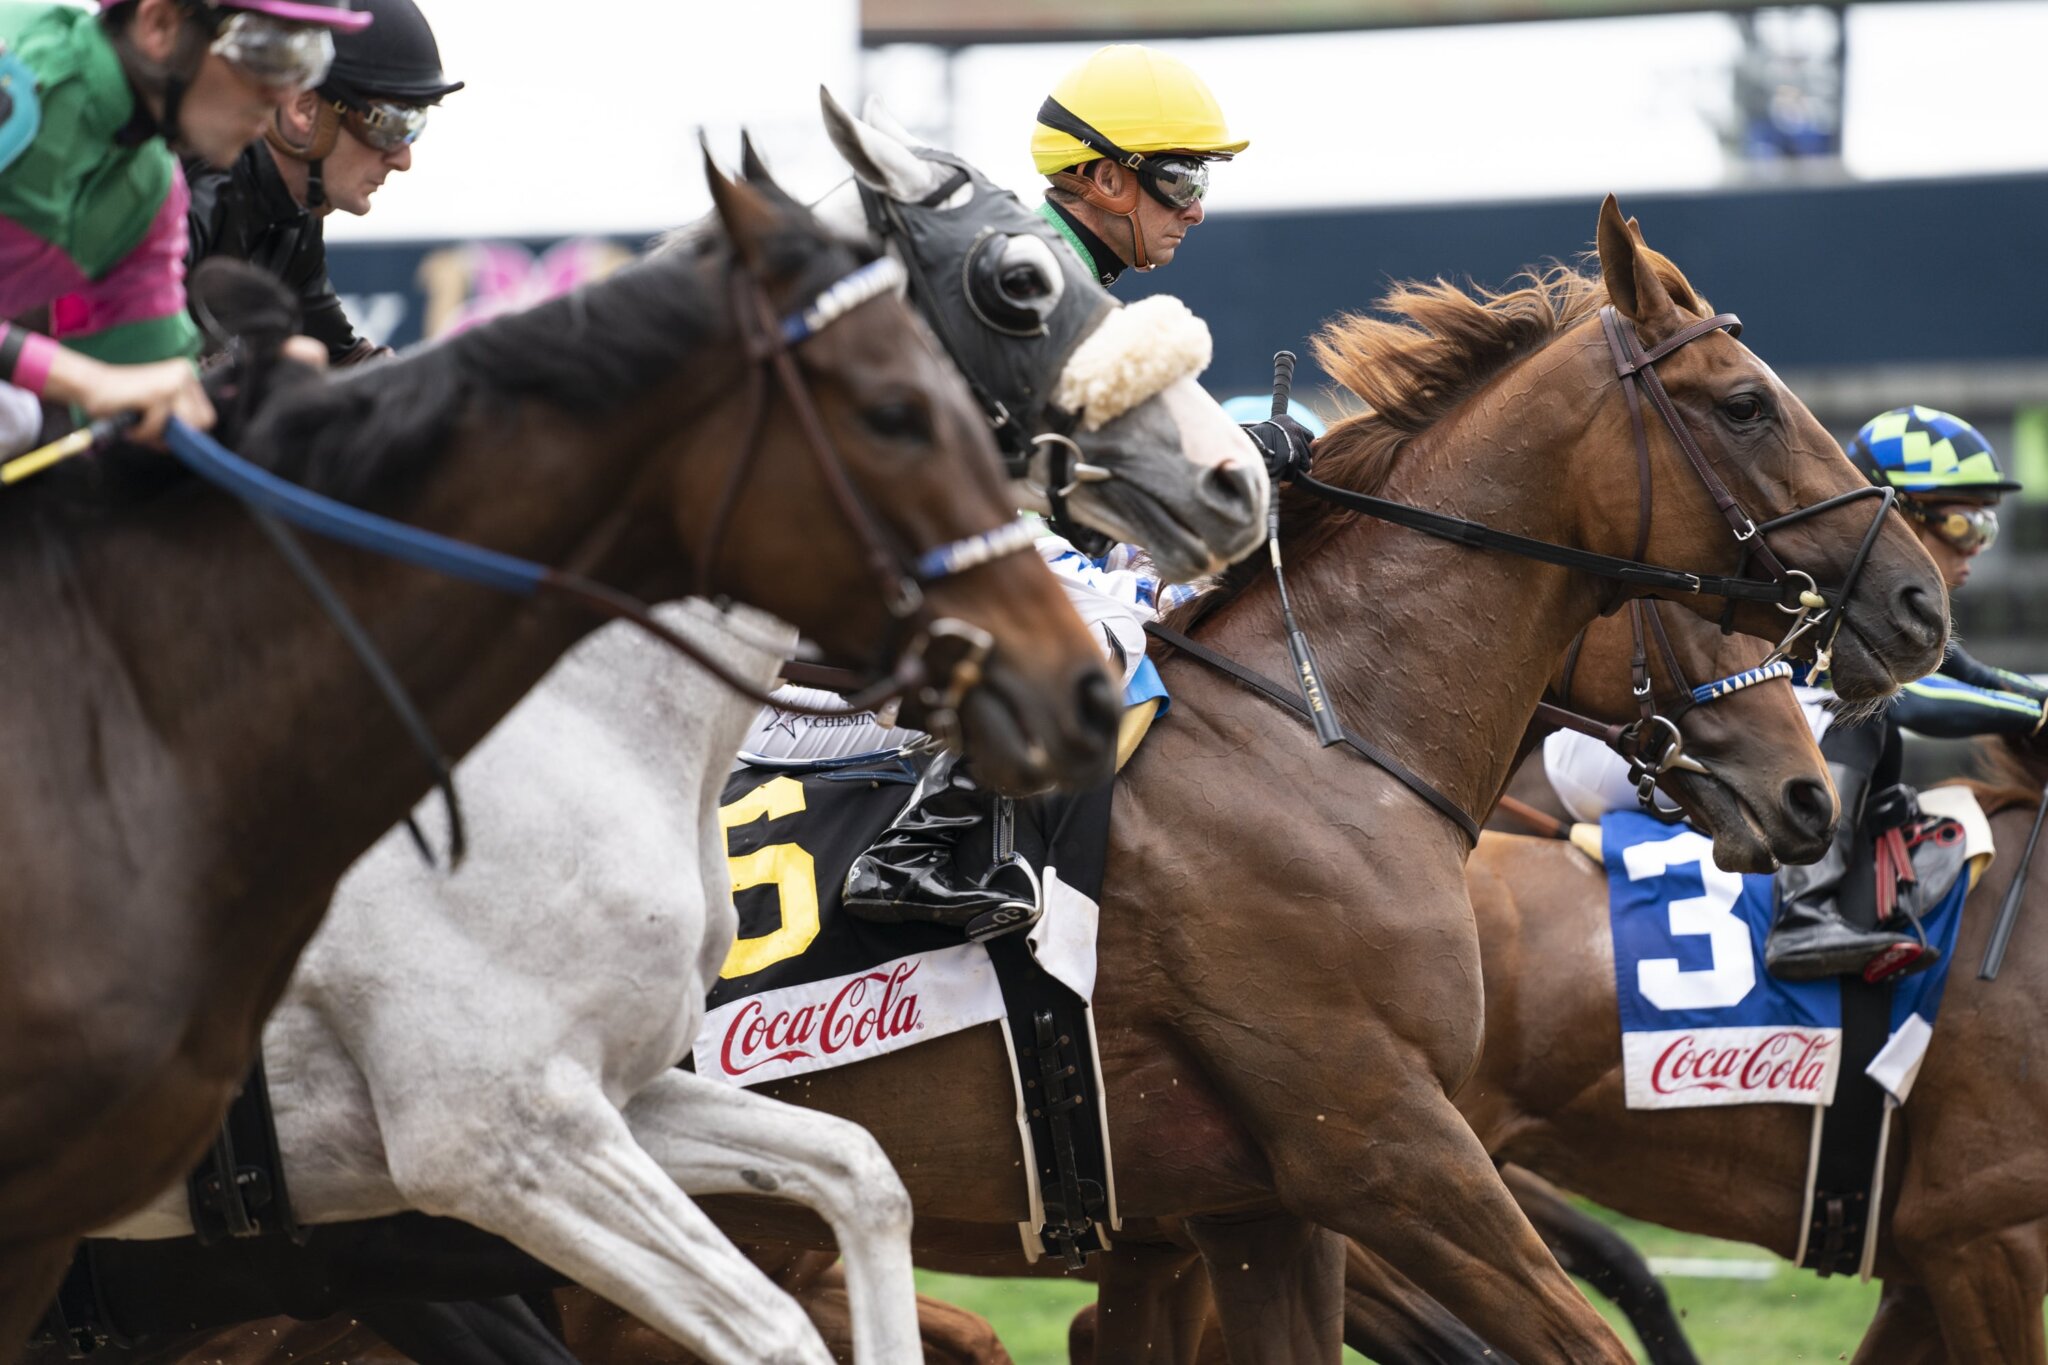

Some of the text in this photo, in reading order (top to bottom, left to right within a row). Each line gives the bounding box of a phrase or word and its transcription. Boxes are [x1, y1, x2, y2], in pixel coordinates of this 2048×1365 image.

[718, 776, 821, 980] 6
[1623, 832, 1757, 1012] 3
[720, 958, 922, 1076] Coca-Cola
[1651, 1032, 1837, 1095] Coca-Cola
